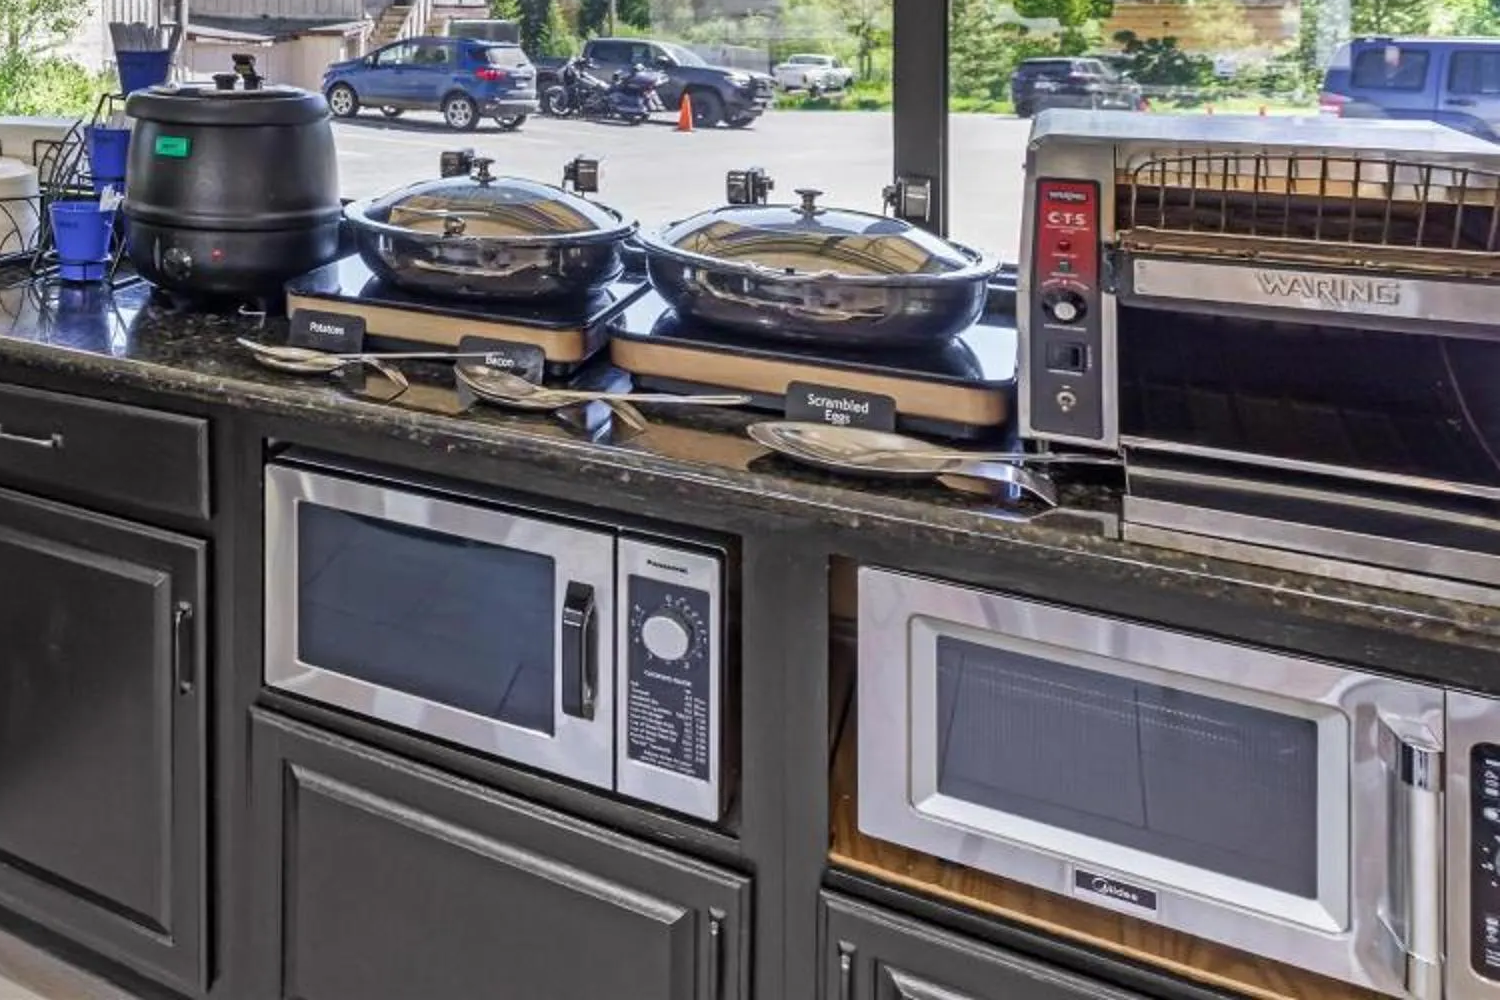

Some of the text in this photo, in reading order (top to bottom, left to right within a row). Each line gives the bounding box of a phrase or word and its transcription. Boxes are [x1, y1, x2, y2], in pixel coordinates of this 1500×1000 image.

[1255, 270, 1400, 307] WARING
[310, 321, 345, 335] Potatoes
[807, 393, 869, 414] Scrambled
[825, 409, 851, 425] Eggs
